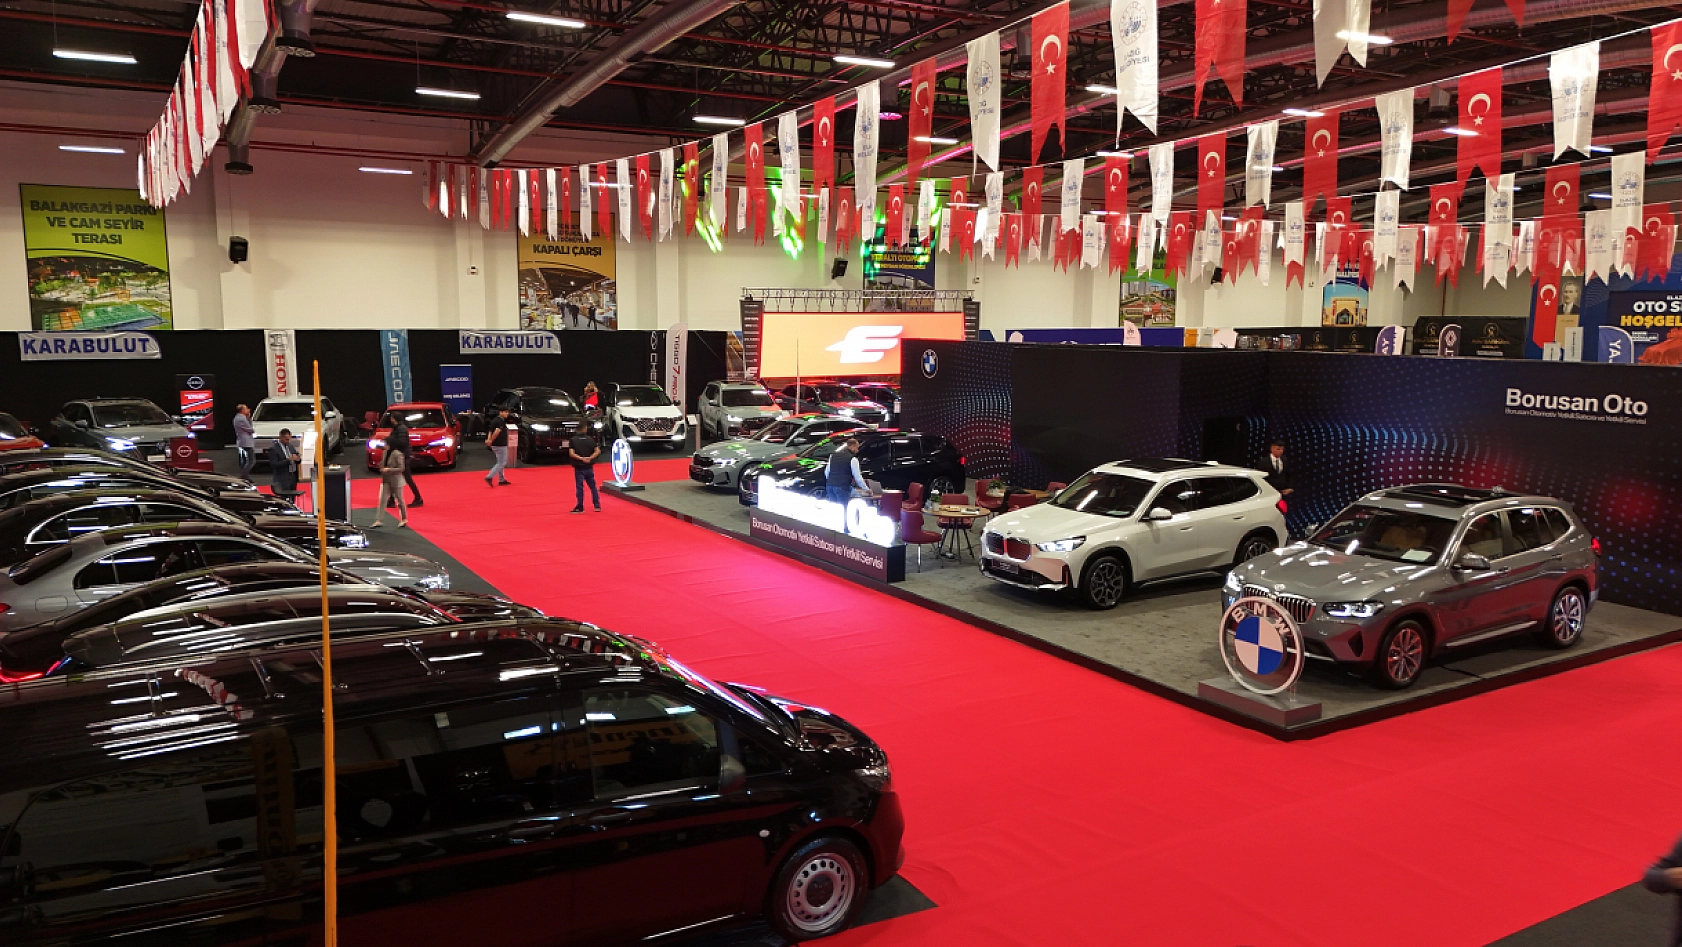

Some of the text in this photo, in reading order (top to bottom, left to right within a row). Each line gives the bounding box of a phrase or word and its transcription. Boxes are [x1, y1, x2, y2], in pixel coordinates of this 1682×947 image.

[30, 200, 113, 215] BALAKGAZİ
[46, 216, 145, 230] VE CAM SEYİR
[72, 232, 122, 245] TERASI
[533, 244, 602, 257] KAPALI ÇARŞI
[1633, 301, 1682, 313] OTO S
[23, 338, 150, 355] KARABULUT
[462, 335, 554, 349] KARABULUT
[388, 331, 404, 403] JAECOO
[1505, 388, 1648, 415] Borusan Oto
[752, 517, 773, 532] Borusan
[860, 551, 884, 570] Servisi
[1231, 602, 1290, 634] BMW
